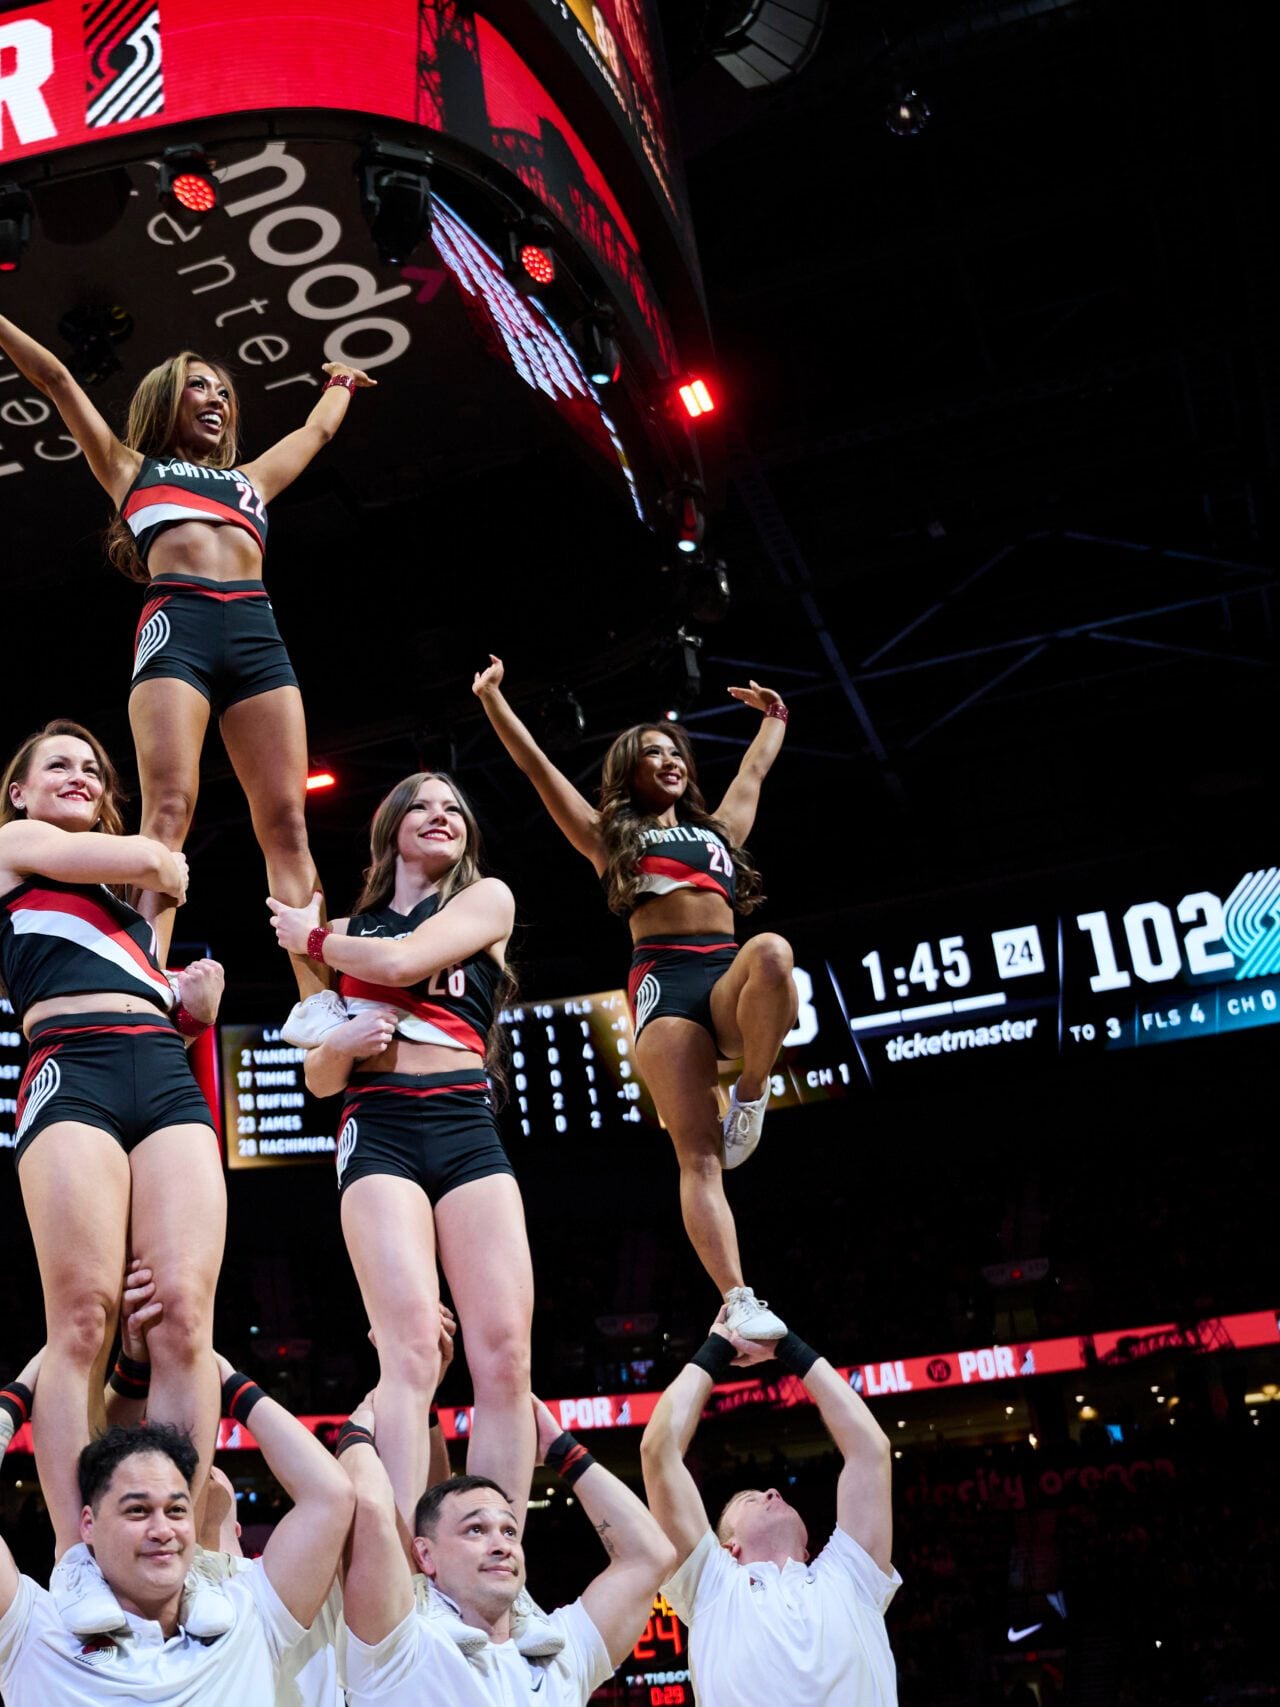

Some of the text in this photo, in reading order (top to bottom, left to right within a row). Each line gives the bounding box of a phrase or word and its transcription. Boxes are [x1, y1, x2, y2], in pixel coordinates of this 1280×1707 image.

[129, 160, 319, 392] enter
[1076, 891, 1235, 993] 102
[861, 935, 972, 1002] 1:45
[1002, 941, 1034, 967] 24
[534, 1004, 553, 1019] TO
[564, 999, 592, 1015] FLS
[1070, 988, 1278, 1043] TO 3 FLS 4 CH 0
[241, 1049, 252, 1067] 2
[253, 1047, 308, 1065] VANDER
[512, 1029, 520, 1046] 1
[546, 1025, 555, 1042] 1
[580, 1020, 590, 1038] 1
[885, 1017, 1038, 1062] ticketmaster
[237, 1071, 252, 1088] 17
[254, 1070, 296, 1088] TIMME
[256, 1092, 304, 1110] BUFKIN
[585, 1065, 595, 1082] 1
[806, 1068, 833, 1088] CH
[838, 1063, 850, 1085] 1
[258, 1115, 302, 1132] JAMES
[518, 1096, 528, 1113] 1
[588, 1088, 597, 1105] 1
[259, 1136, 337, 1155] HACHIMURA
[521, 1119, 530, 1136] 1
[864, 1346, 1015, 1396] LAL VS POR
[559, 1396, 612, 1429] POR
[633, 1615, 682, 1660] 24
